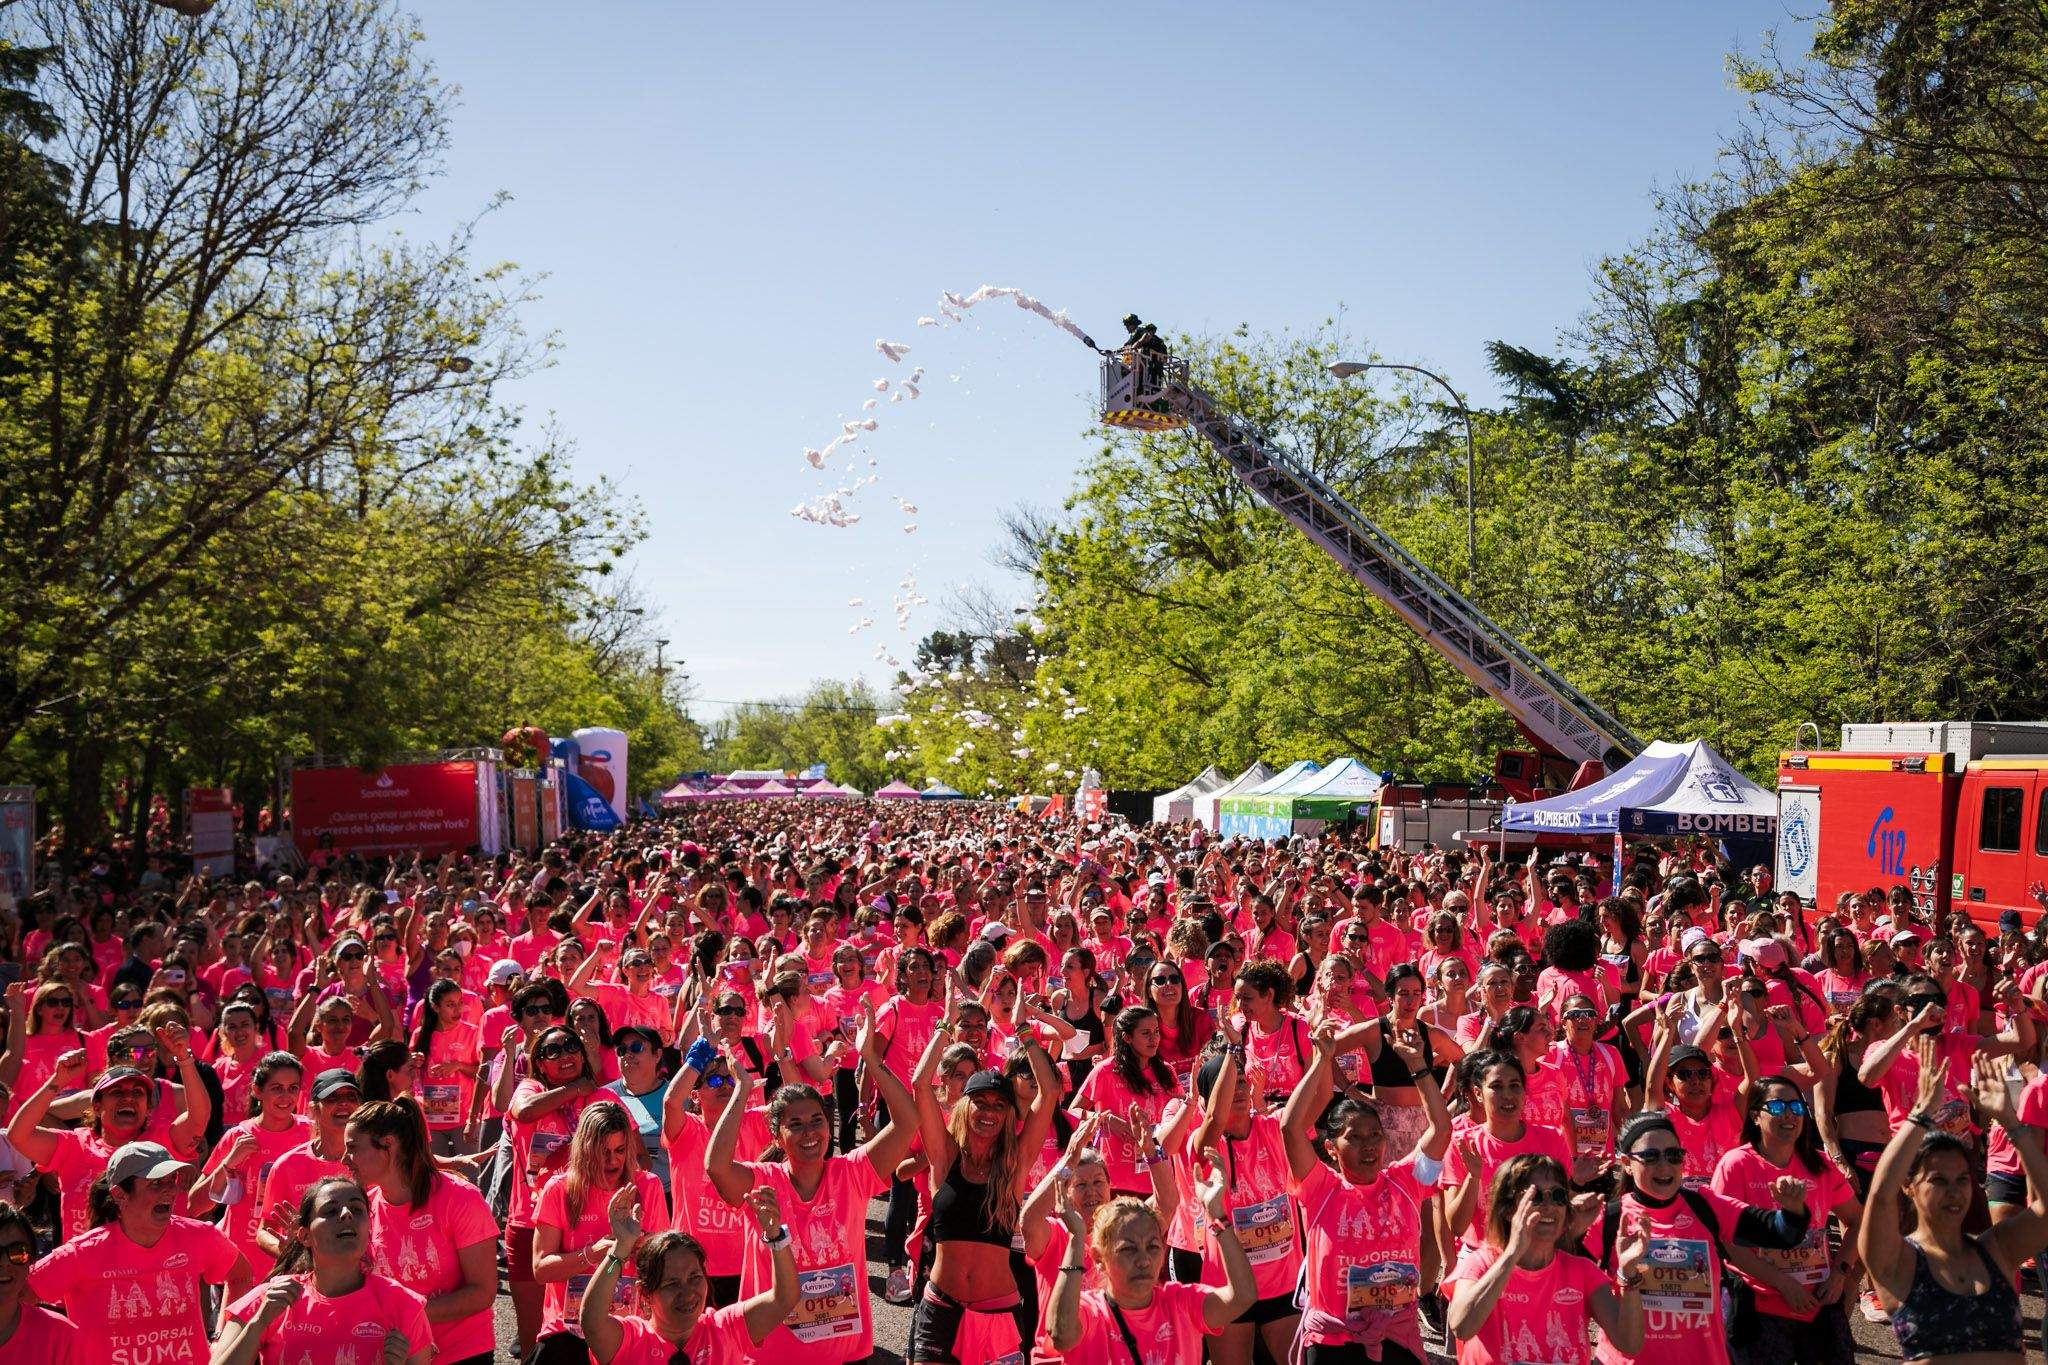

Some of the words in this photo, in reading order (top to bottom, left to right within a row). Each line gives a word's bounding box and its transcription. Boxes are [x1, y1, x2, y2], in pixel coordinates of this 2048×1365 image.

[361, 788, 409, 798] Santander
[413, 806, 435, 819] viaje
[1534, 810, 1581, 827] BOMBEROS
[376, 823, 403, 834] Mujer
[420, 820, 441, 831] New
[443, 818, 470, 829] York?
[1881, 829, 1906, 876] 112
[700, 1196, 713, 1207] TU
[698, 1208, 742, 1229] SUM
[1255, 1223, 1280, 1237] 016
[1249, 1253, 1266, 1261] YSHO
[1337, 1255, 1356, 1266] TU
[1781, 1249, 1809, 1259] 016
[1654, 1268, 1689, 1281] 016
[804, 1282, 835, 1291] ASTURIANA
[1370, 1283, 1397, 1298] 016
[805, 1296, 837, 1311] 016
[285, 1320, 321, 1334] OYSHO
[1649, 1310, 1710, 1331] UMA
[110, 1336, 131, 1347] TU
[136, 1326, 195, 1346] DORSAL
[112, 1339, 193, 1365] SUMA
